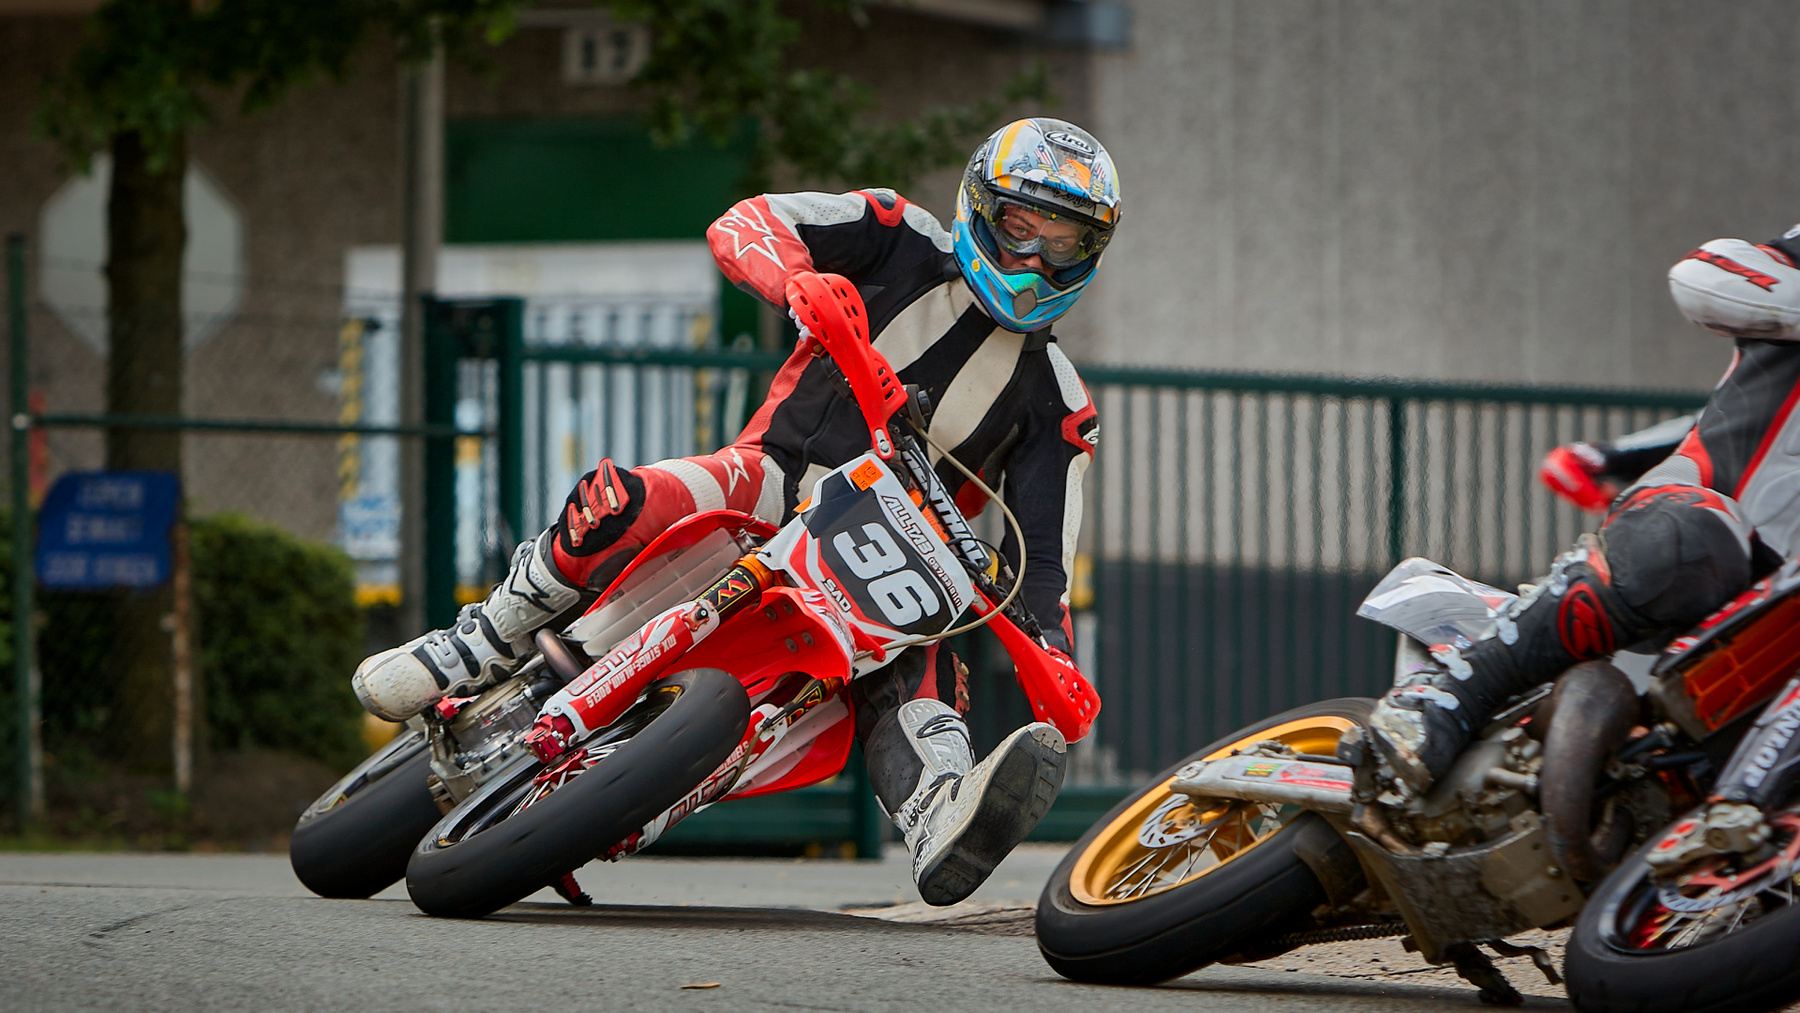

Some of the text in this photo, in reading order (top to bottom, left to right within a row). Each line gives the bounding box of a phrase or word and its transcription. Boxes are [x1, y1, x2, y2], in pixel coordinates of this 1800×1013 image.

[1050, 132, 1090, 151] Arai
[832, 521, 941, 627] 36
[821, 578, 852, 613] SAD
[660, 633, 677, 653] MX
[1744, 692, 1800, 788] UNLOP
